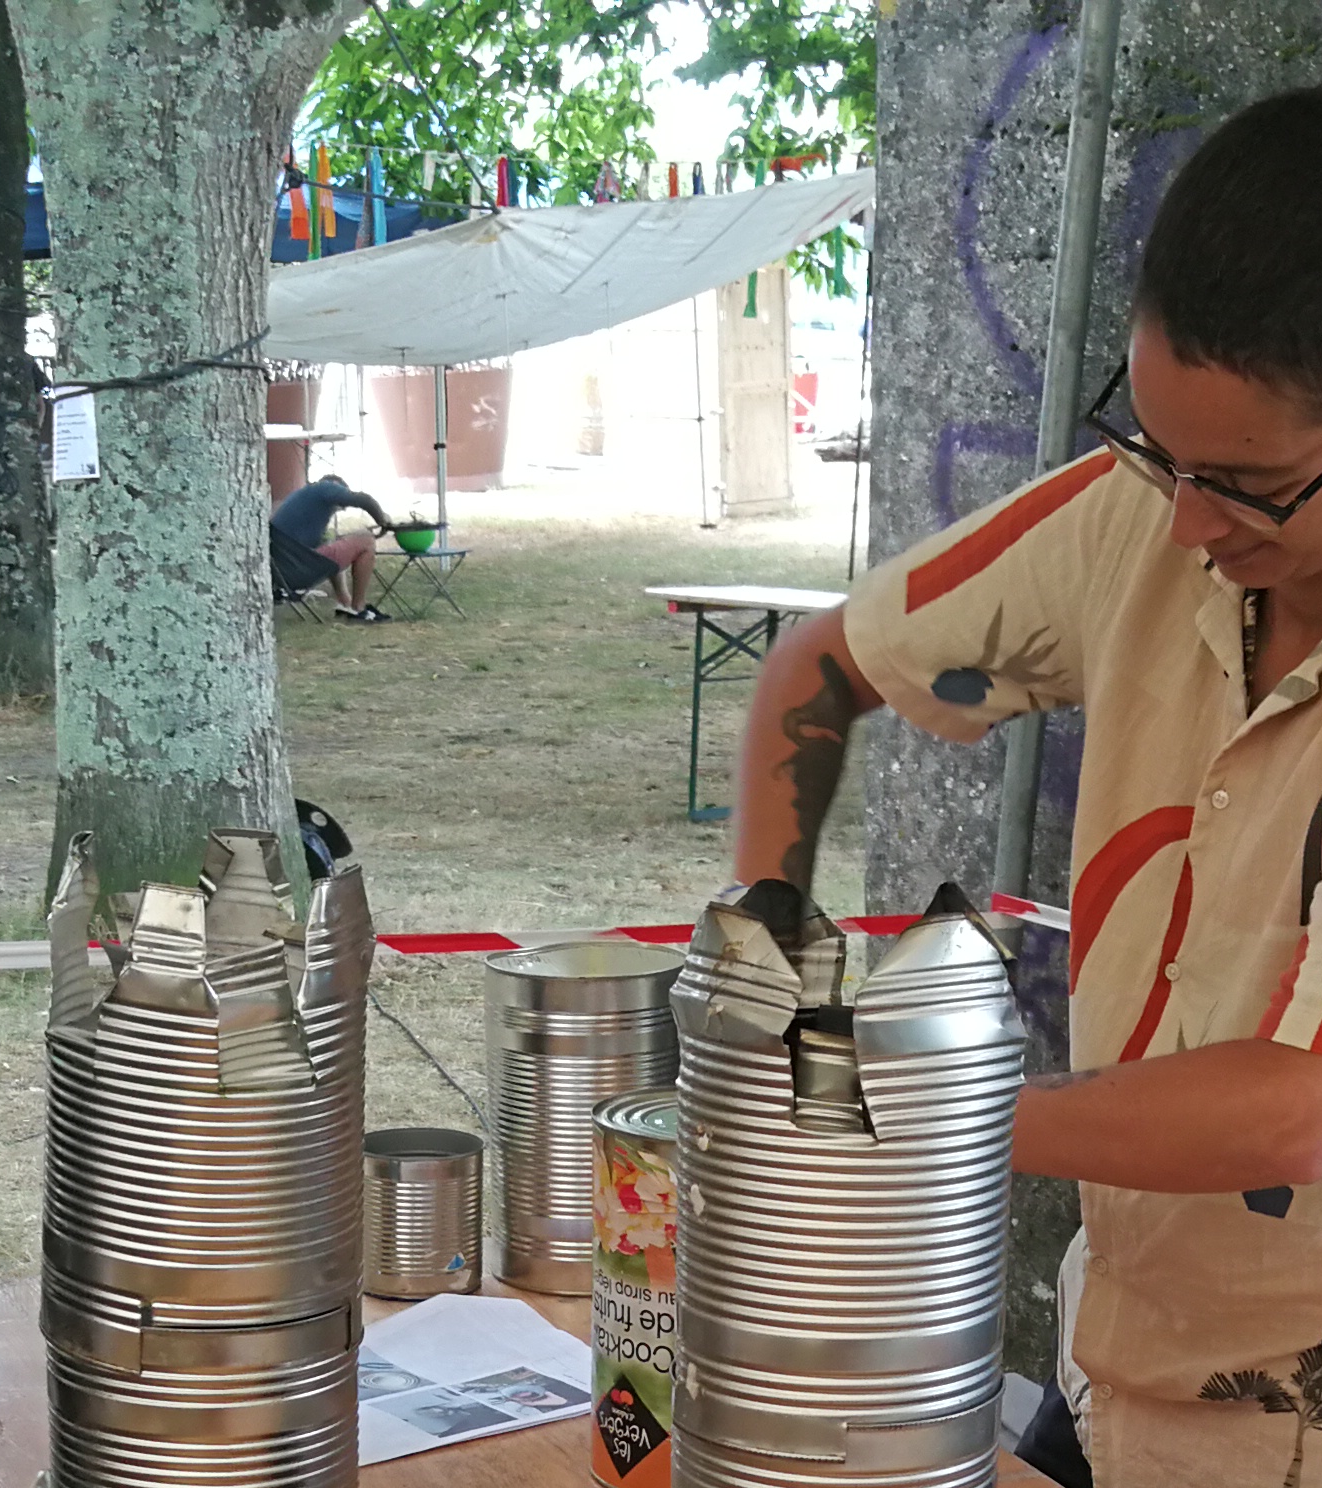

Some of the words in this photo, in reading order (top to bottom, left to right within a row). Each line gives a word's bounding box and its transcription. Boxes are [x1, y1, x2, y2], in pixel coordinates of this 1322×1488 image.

[615, 1279, 652, 1305] sirop
[594, 1291, 633, 1332] fruits
[639, 1309, 675, 1339] de
[599, 1411, 652, 1450] Vergers
[613, 1437, 631, 1463] les
